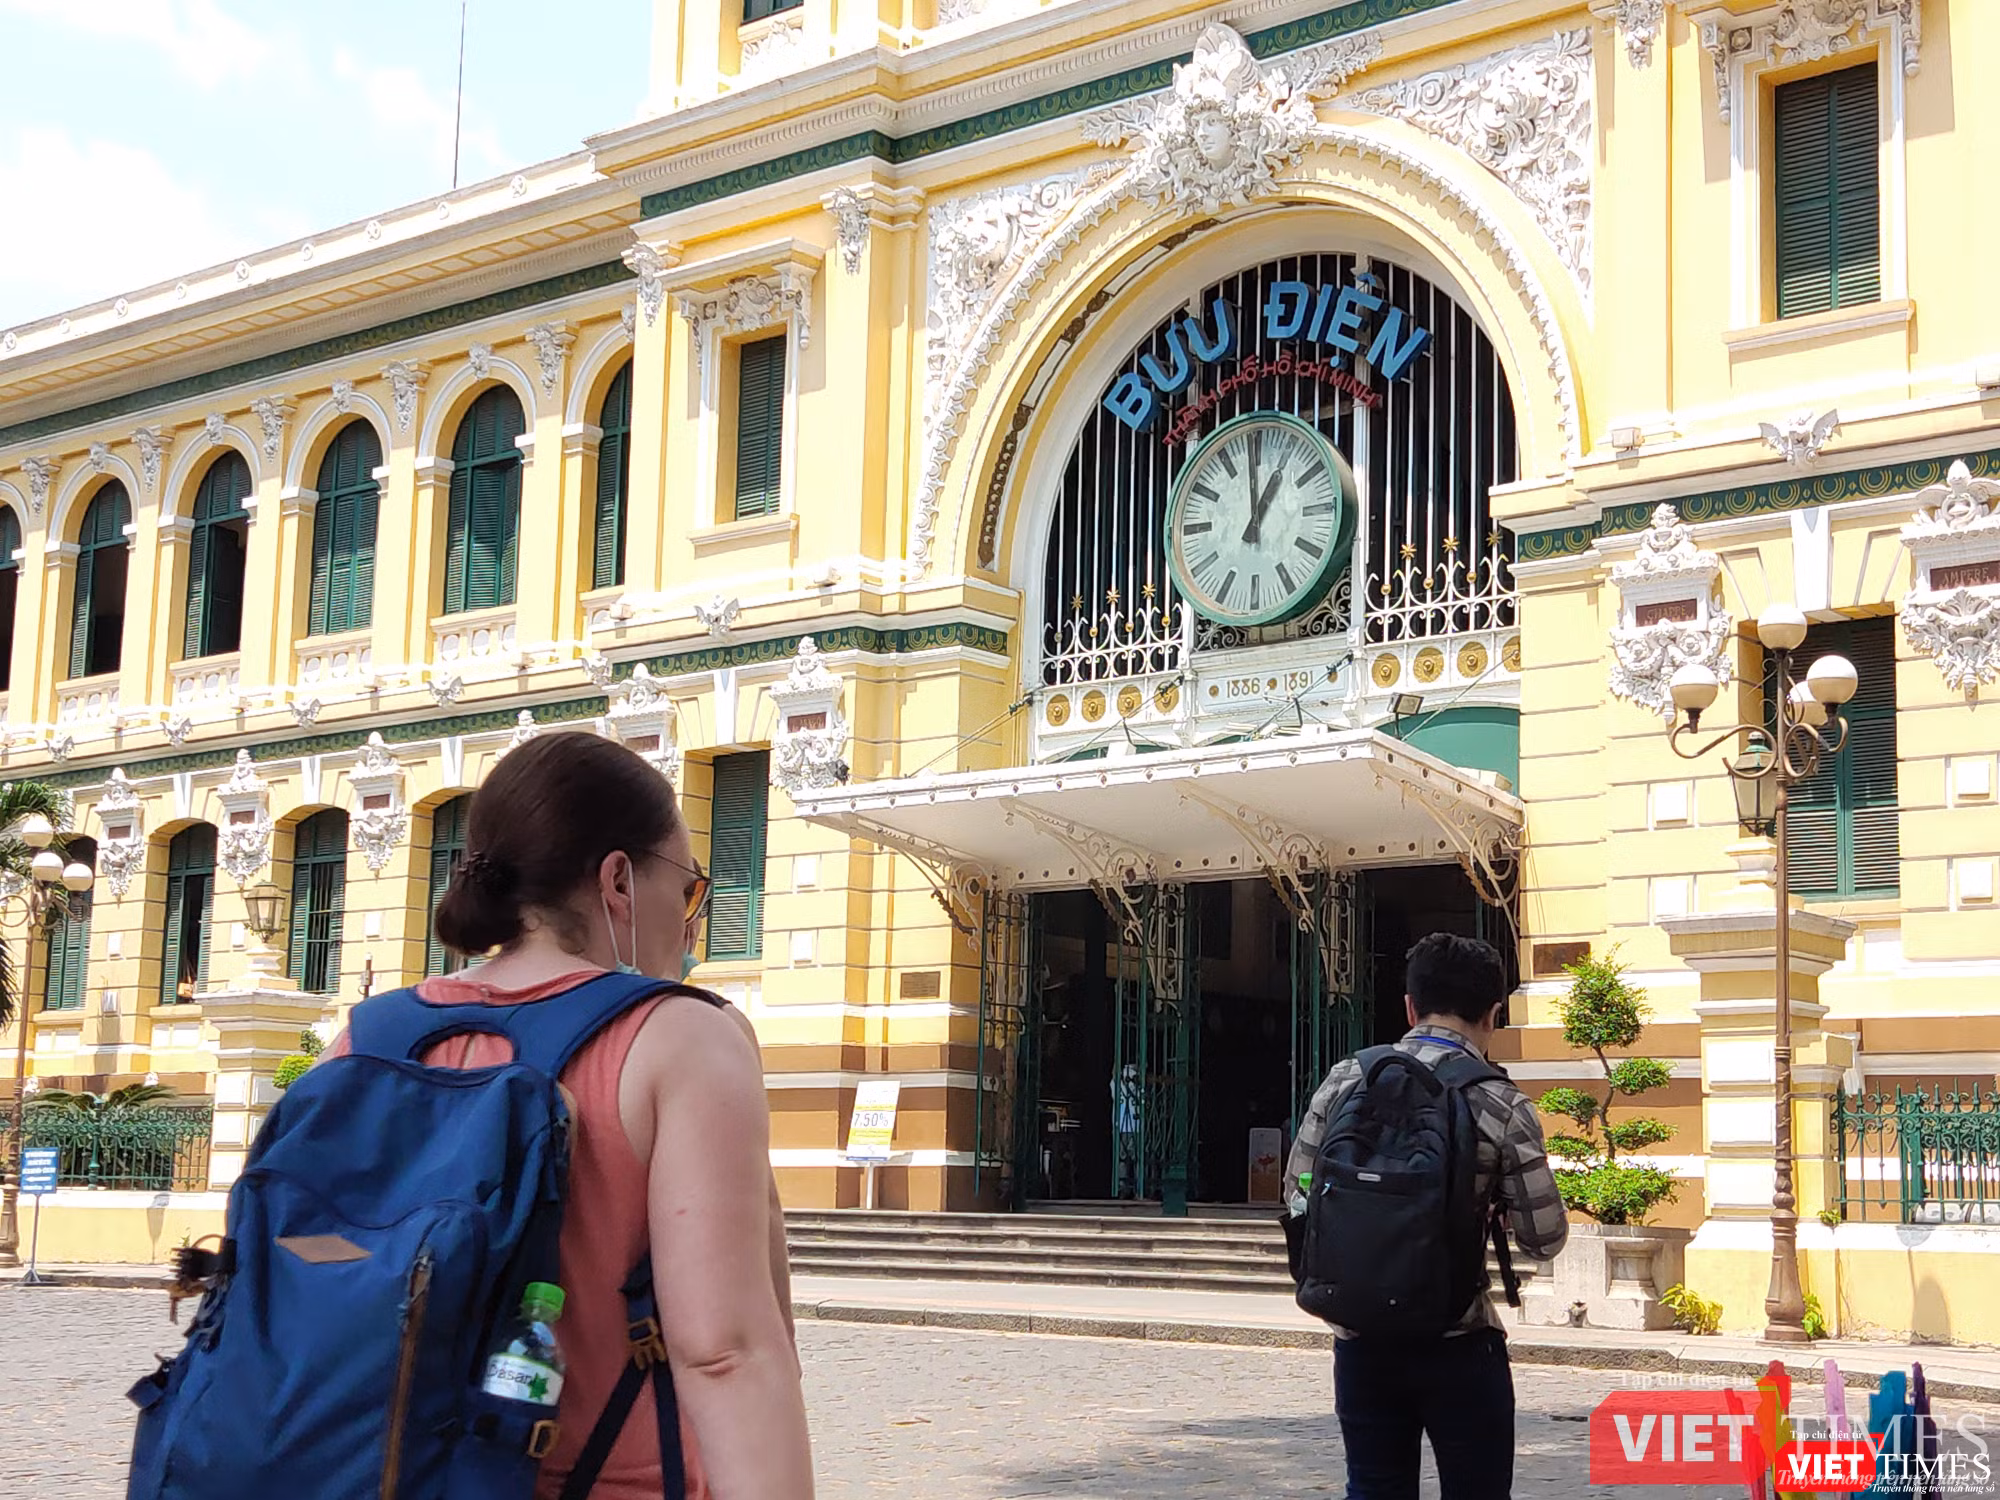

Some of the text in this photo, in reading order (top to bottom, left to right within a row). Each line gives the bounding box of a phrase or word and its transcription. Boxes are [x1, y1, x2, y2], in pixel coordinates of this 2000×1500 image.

[1263, 272, 1432, 382] ĐIỆN
[1219, 354, 1258, 397] PHỐ
[1263, 350, 1293, 378] HỒ
[1298, 357, 1329, 381] CHÍ
[1329, 369, 1380, 408] MINH
[1227, 678, 1261, 698] 1886
[1284, 671, 1314, 690] 1891
